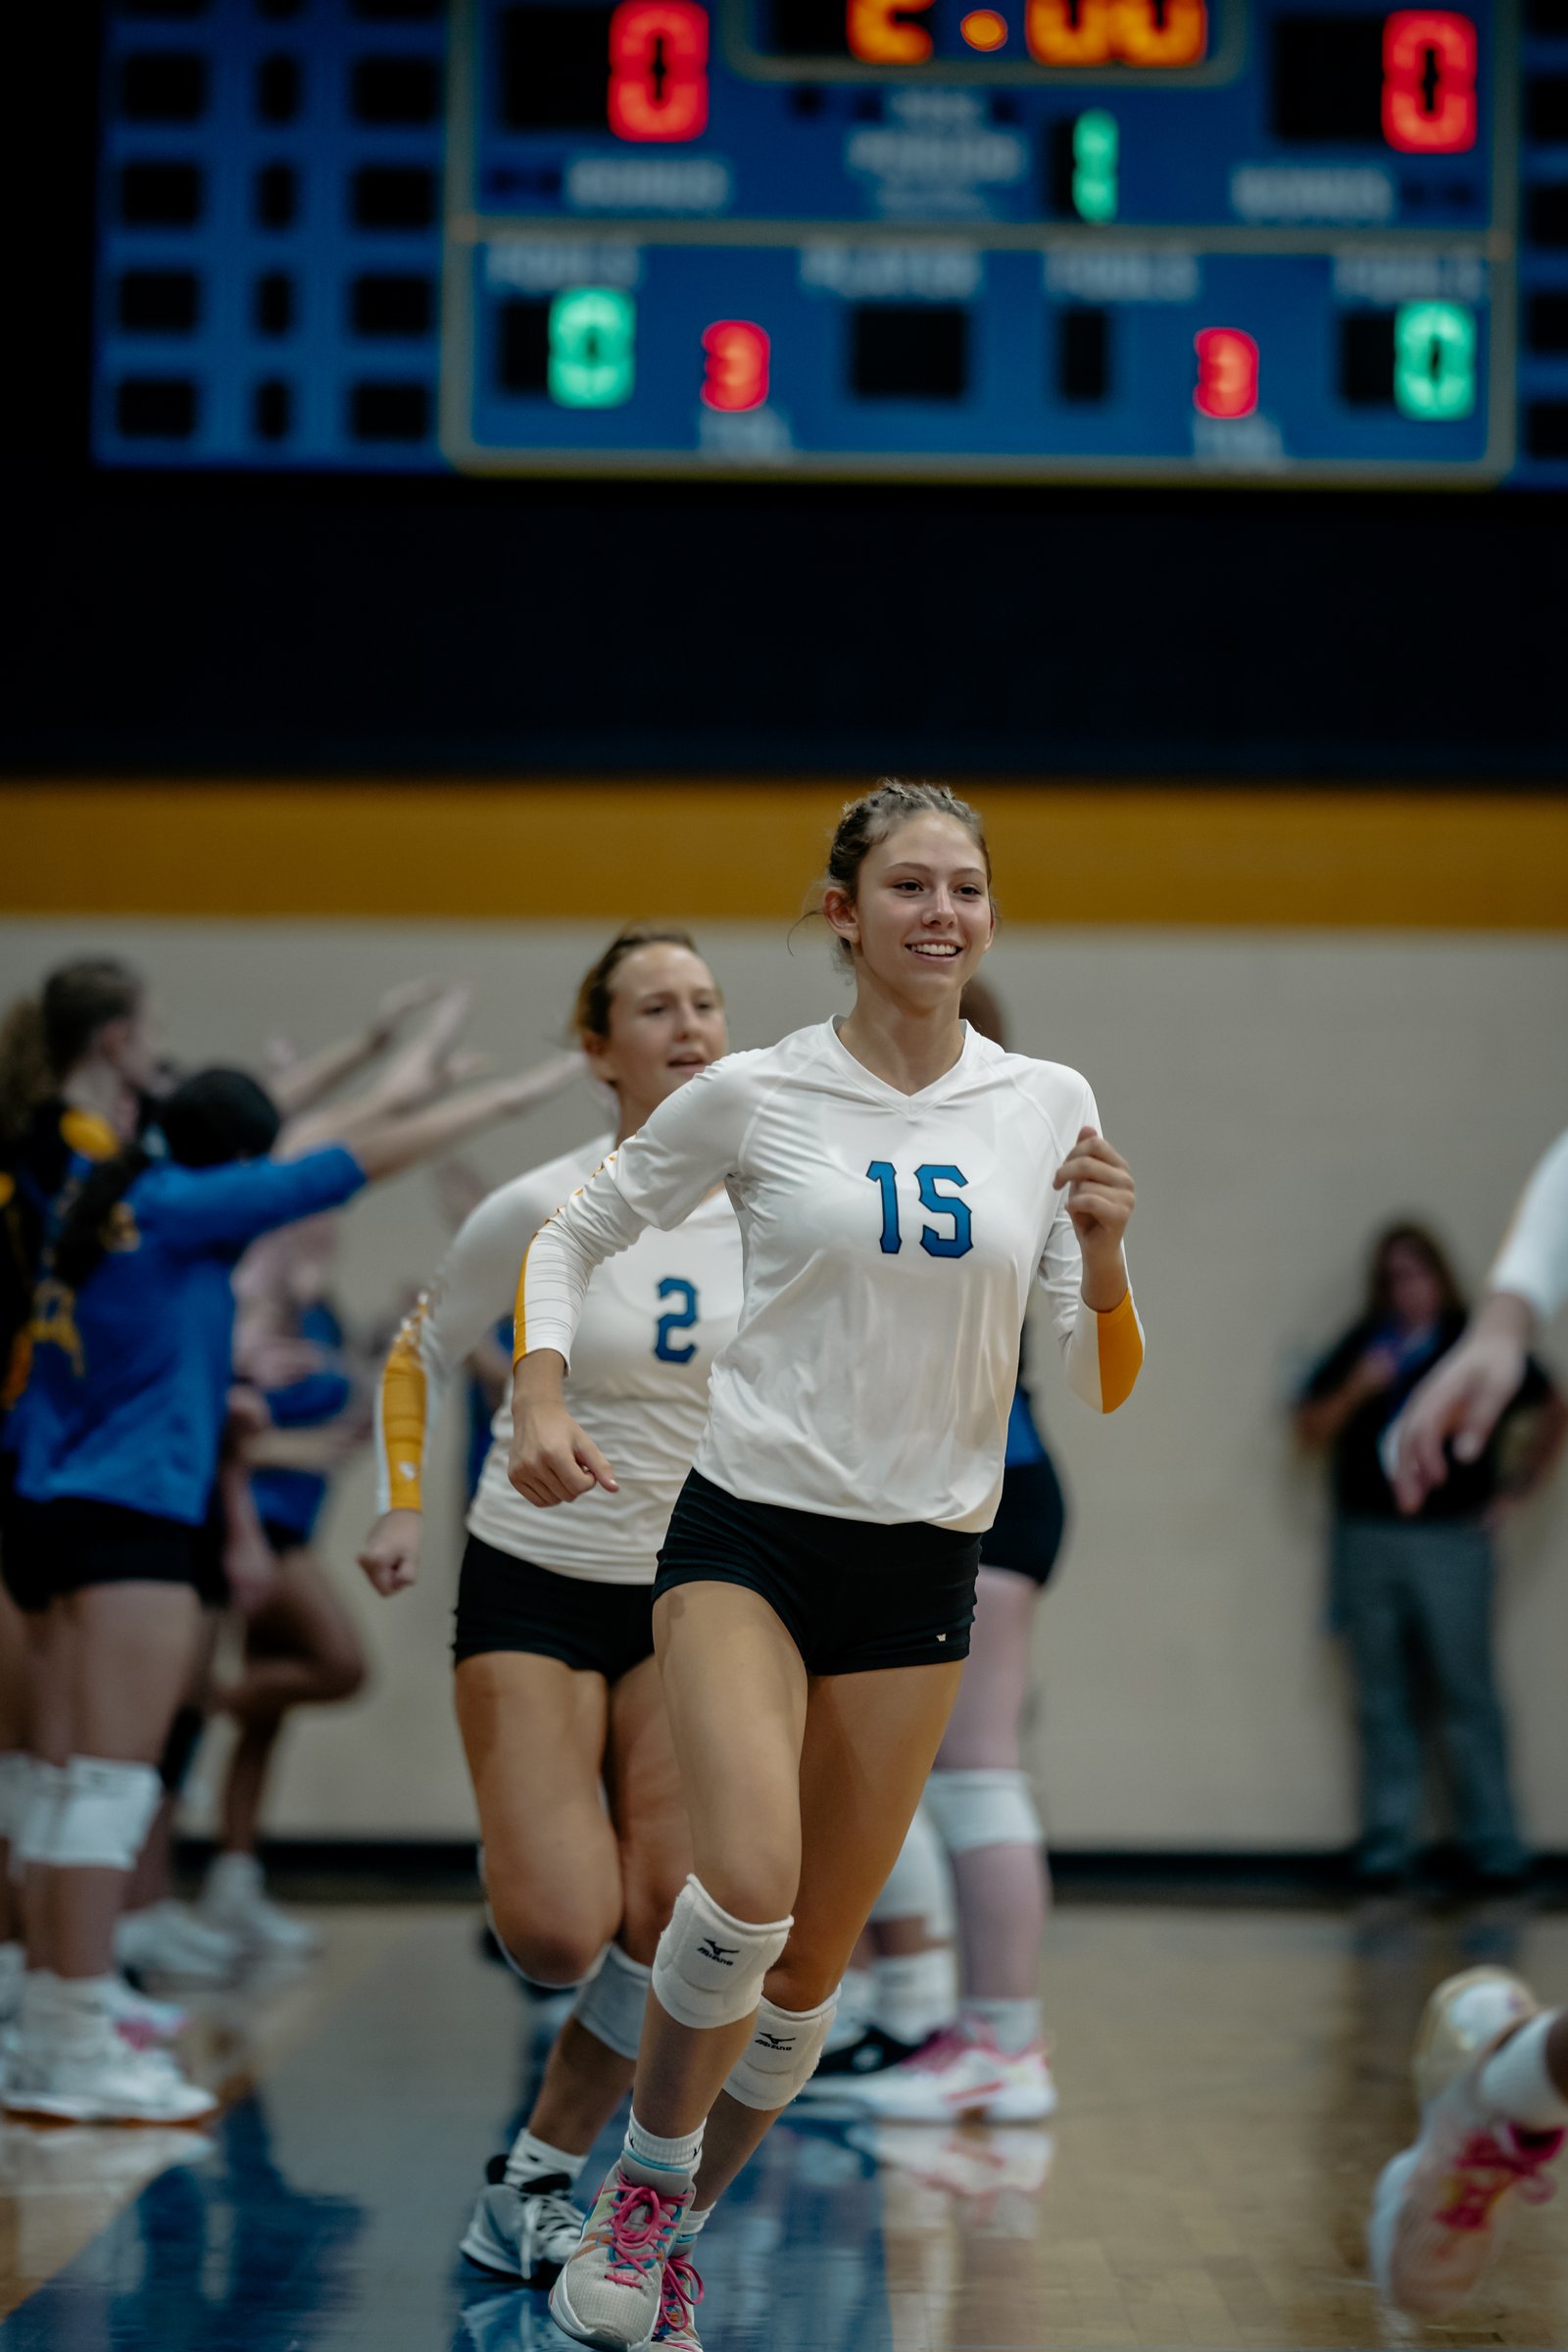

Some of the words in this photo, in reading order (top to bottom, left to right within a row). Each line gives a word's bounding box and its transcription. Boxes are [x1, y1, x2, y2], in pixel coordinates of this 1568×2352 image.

[609, 0, 709, 142] 0
[1381, 9, 1477, 154] 0
[548, 287, 635, 408] 0
[1393, 301, 1476, 421] 0
[865, 1160, 974, 1259] 15
[654, 1277, 700, 1364] 2
